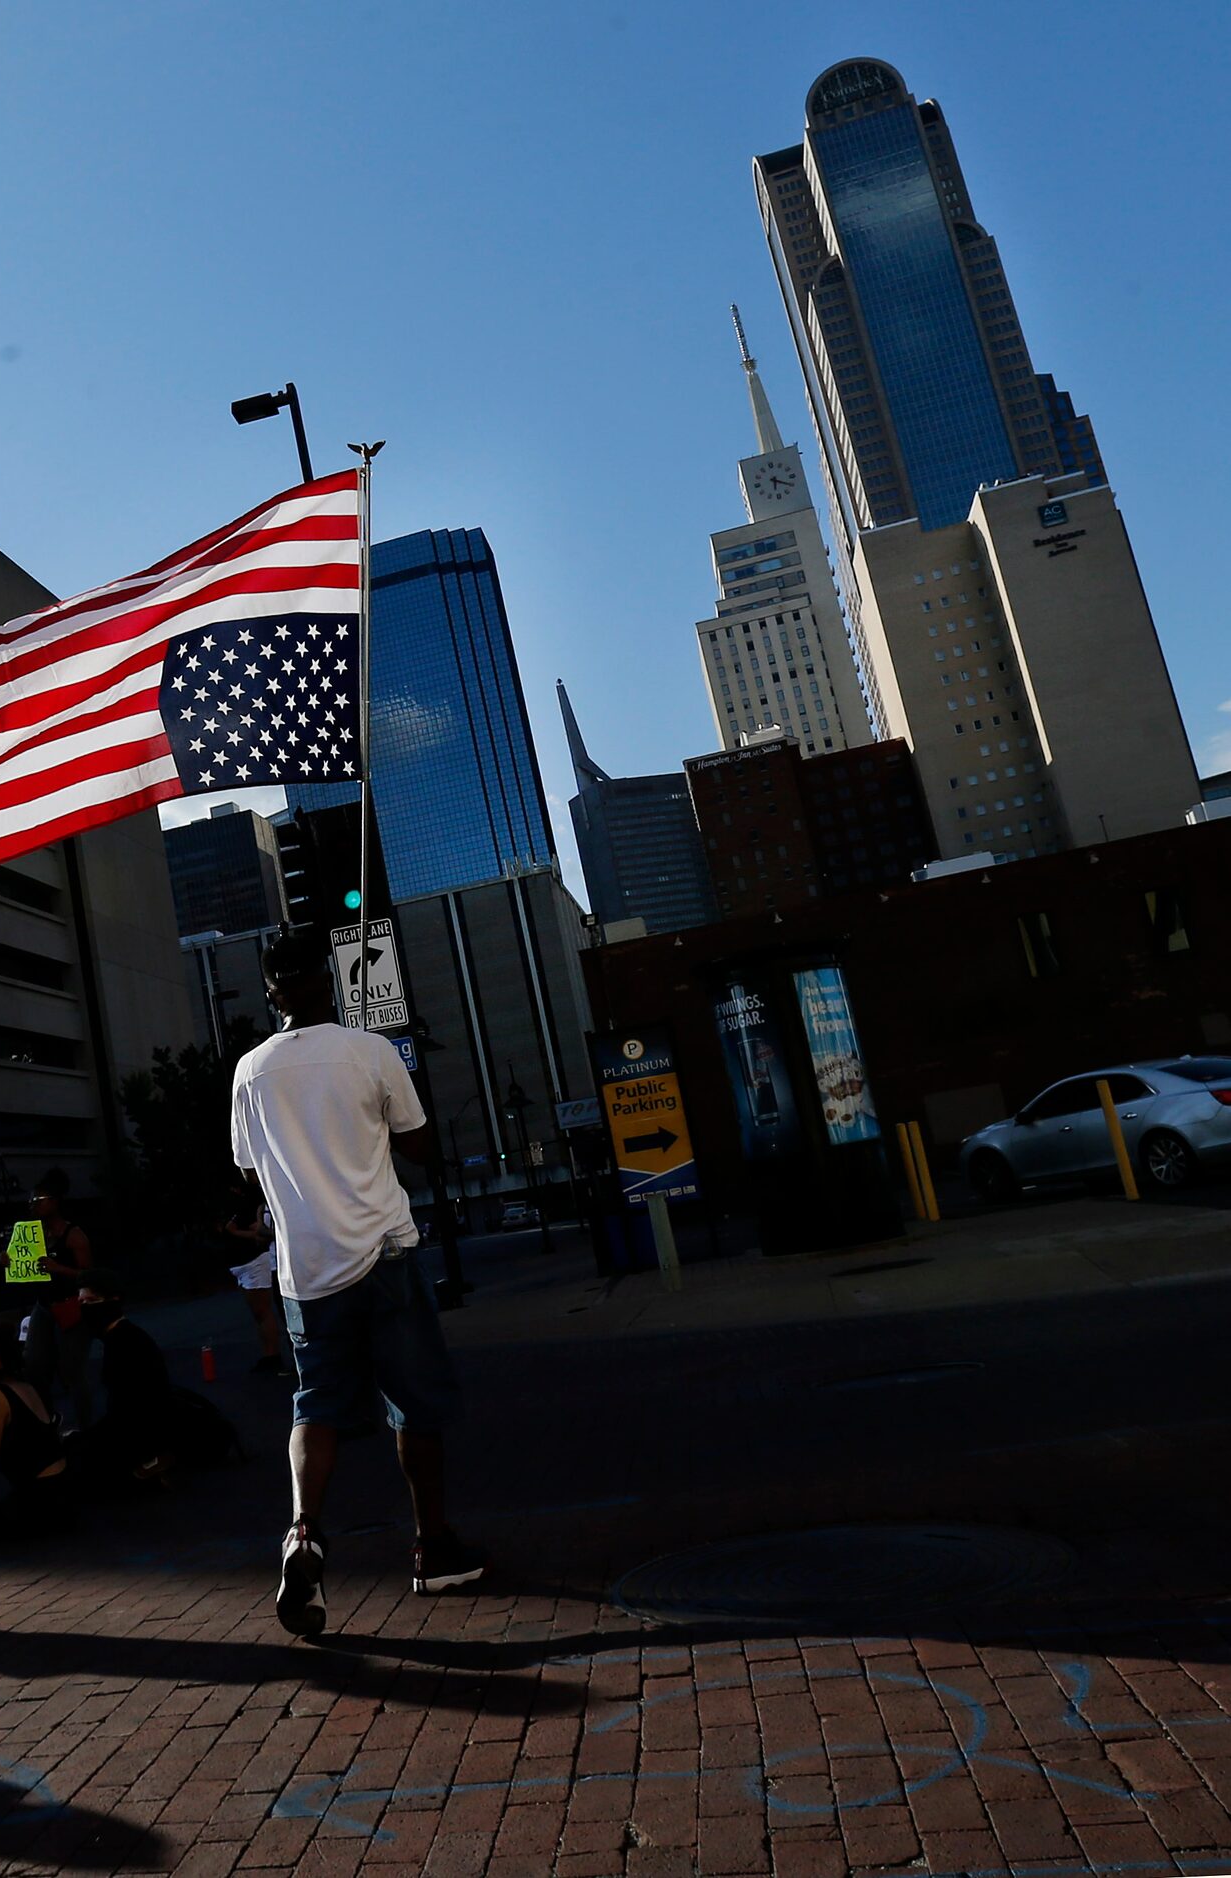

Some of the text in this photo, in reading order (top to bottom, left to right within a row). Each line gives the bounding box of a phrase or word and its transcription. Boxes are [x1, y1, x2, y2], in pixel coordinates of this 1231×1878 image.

[1044, 505, 1062, 516] AC
[333, 928, 361, 944] RIGHT
[350, 982, 393, 1002] ONLY
[349, 1006, 403, 1029] EXPT BUSES
[726, 1010, 765, 1031] SUGAR.
[627, 1043, 637, 1055] P
[602, 1057, 670, 1078] PLATINUM
[615, 1080, 667, 1099] Public
[612, 1097, 677, 1117] Parking
[15, 1245, 32, 1258] FOR
